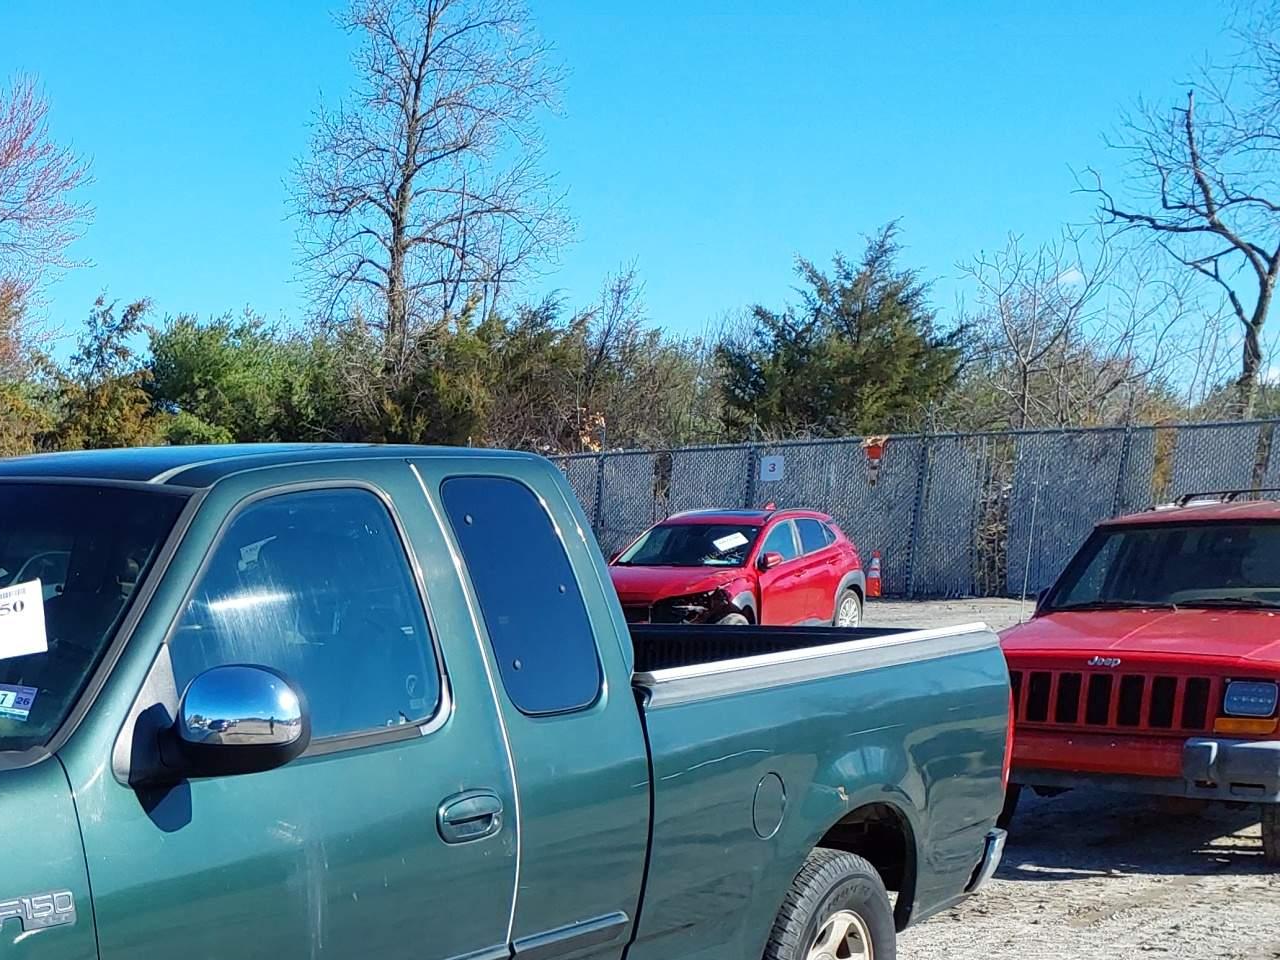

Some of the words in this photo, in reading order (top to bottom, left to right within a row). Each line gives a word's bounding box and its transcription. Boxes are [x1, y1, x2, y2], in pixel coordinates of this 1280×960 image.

[768, 463, 777, 472] 3
[1087, 655, 1121, 668] Jeep
[0, 693, 9, 705] 7
[16, 697, 31, 706] 26
